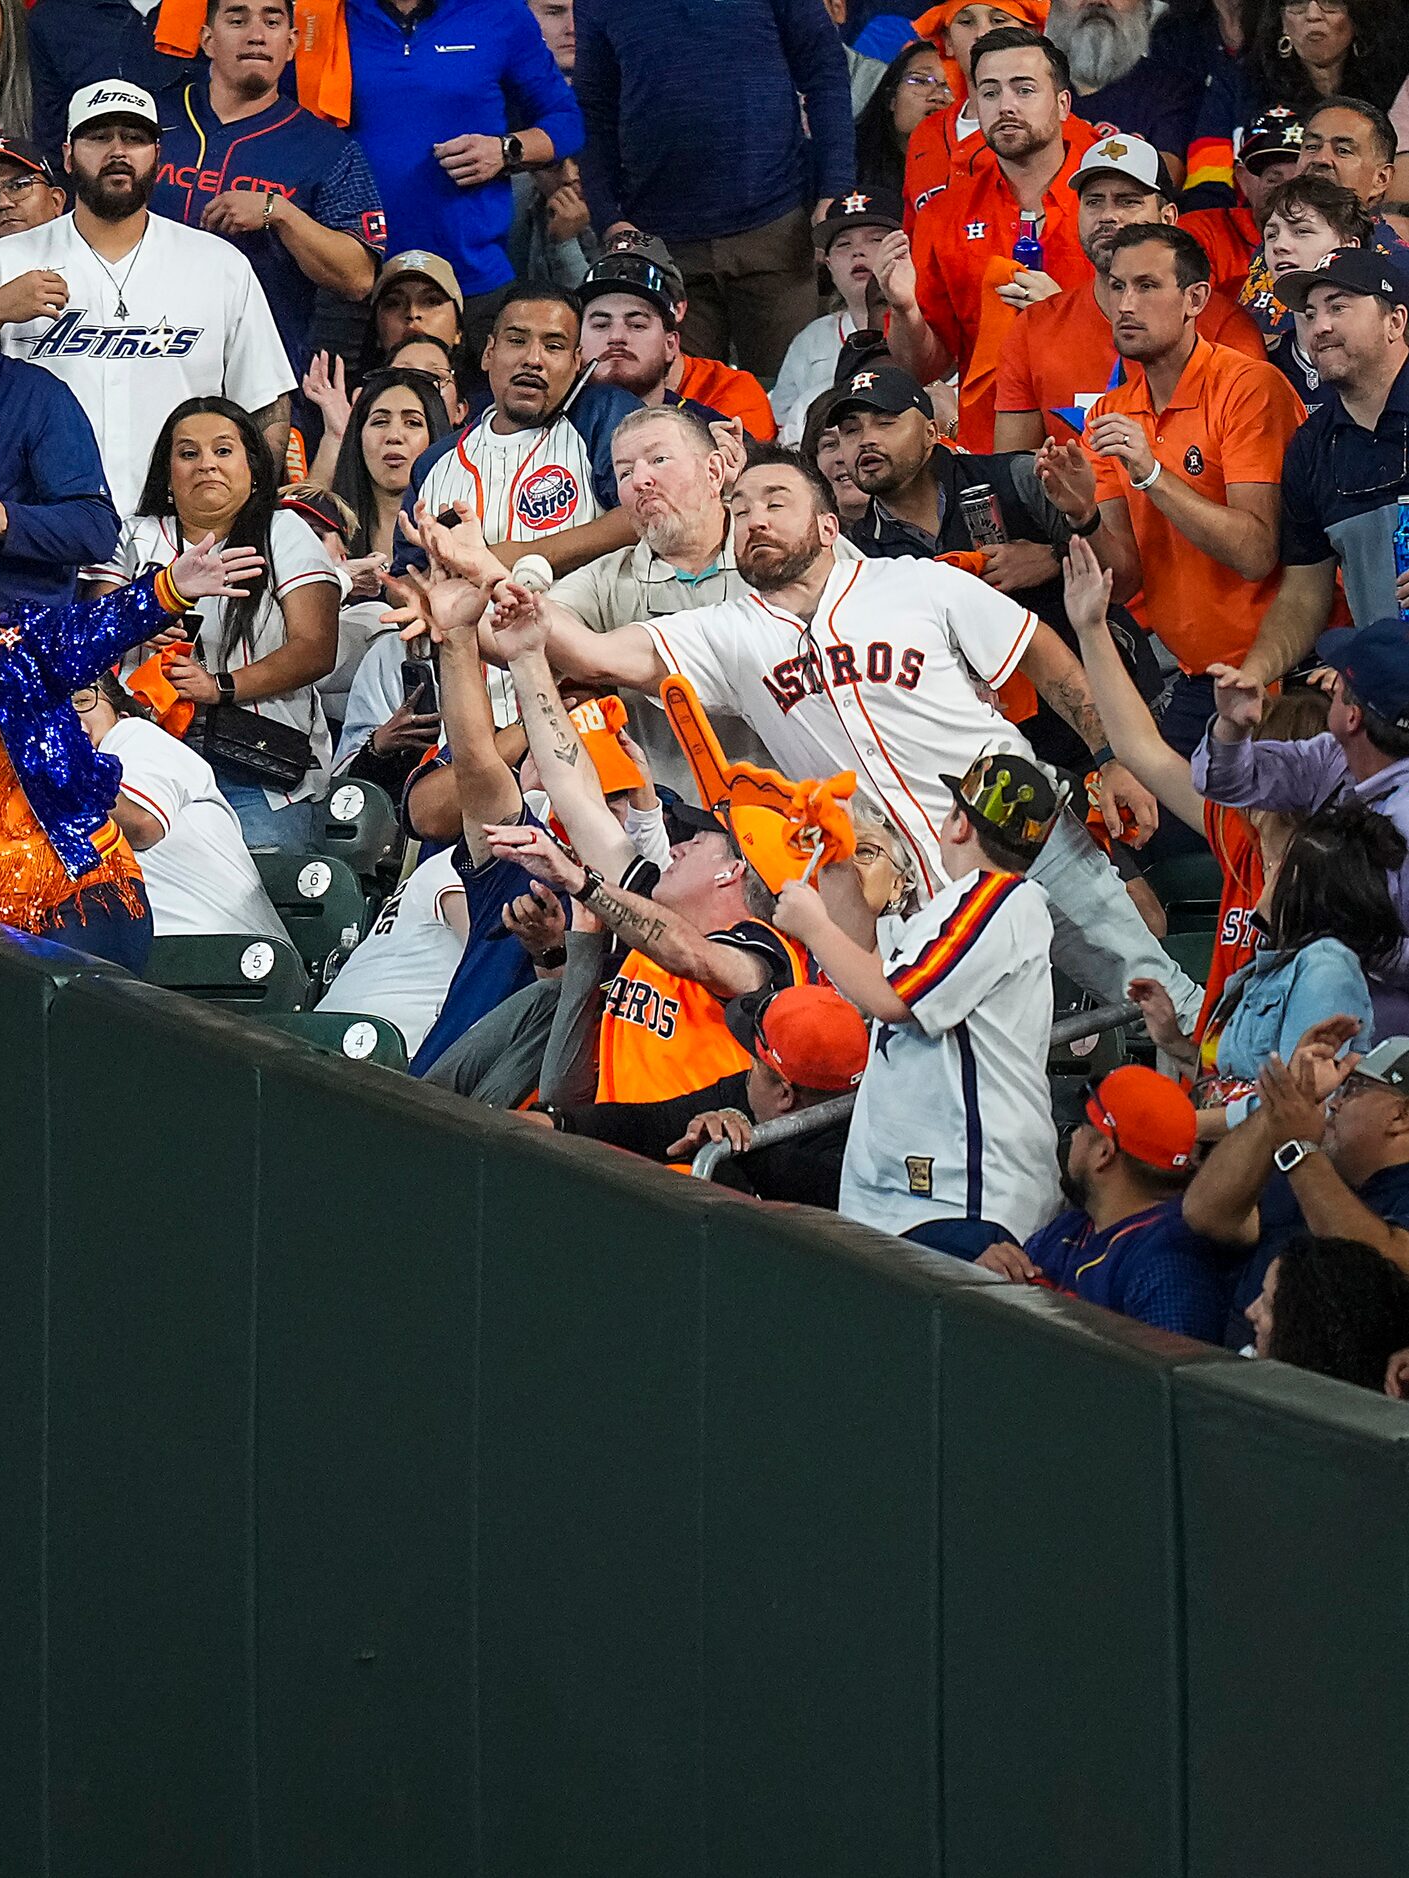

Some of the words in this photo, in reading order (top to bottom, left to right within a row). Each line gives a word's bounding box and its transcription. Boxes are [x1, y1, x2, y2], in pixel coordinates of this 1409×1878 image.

[86, 89, 147, 108] ASTROS
[845, 195, 866, 213] H
[967, 222, 986, 240] H
[11, 309, 205, 359] ASTROS
[852, 372, 874, 391] H
[517, 478, 577, 520] Astros
[762, 641, 926, 717] ASTROS
[344, 797, 351, 809] 7
[310, 872, 319, 886] 6
[252, 955, 261, 968] 5
[355, 1035, 363, 1048] 4
